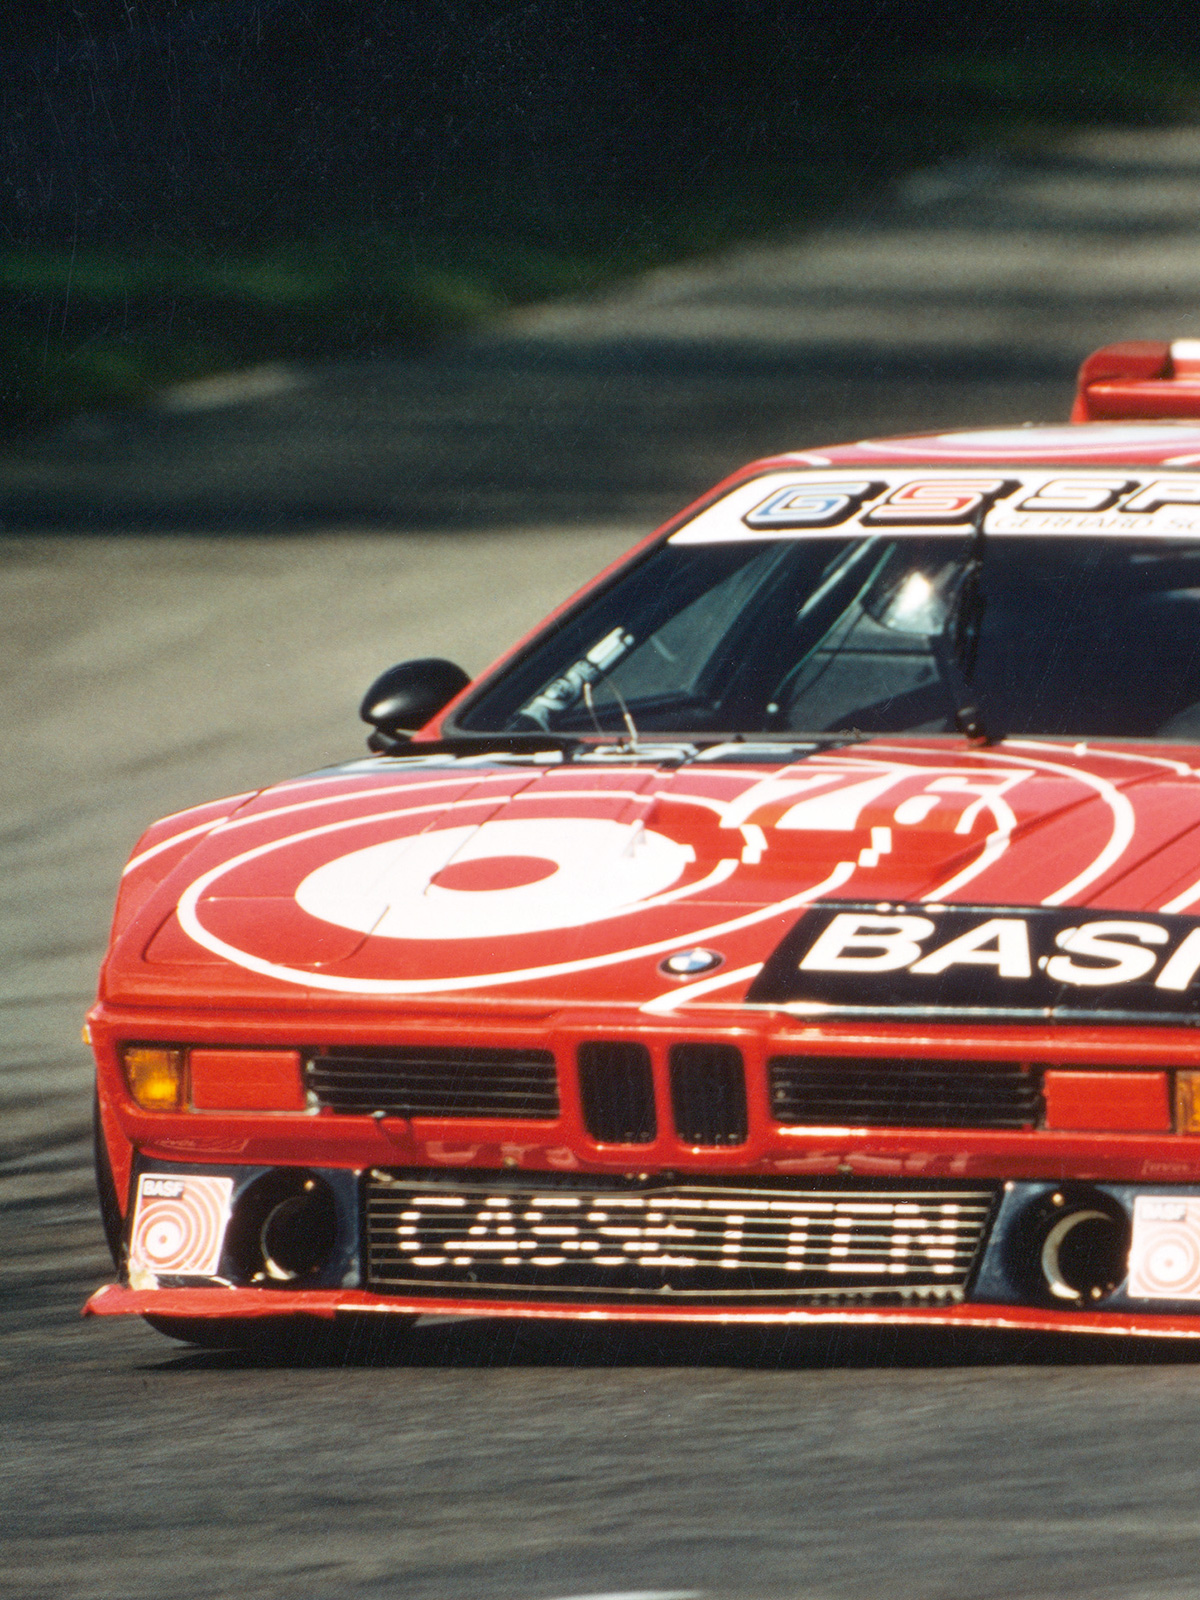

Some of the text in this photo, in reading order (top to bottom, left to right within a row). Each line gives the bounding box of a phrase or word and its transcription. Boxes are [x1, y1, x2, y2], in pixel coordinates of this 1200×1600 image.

[741, 479, 1022, 531] GS
[143, 1179, 184, 1198] BASF
[396, 1194, 969, 1276] CASSETTEN
